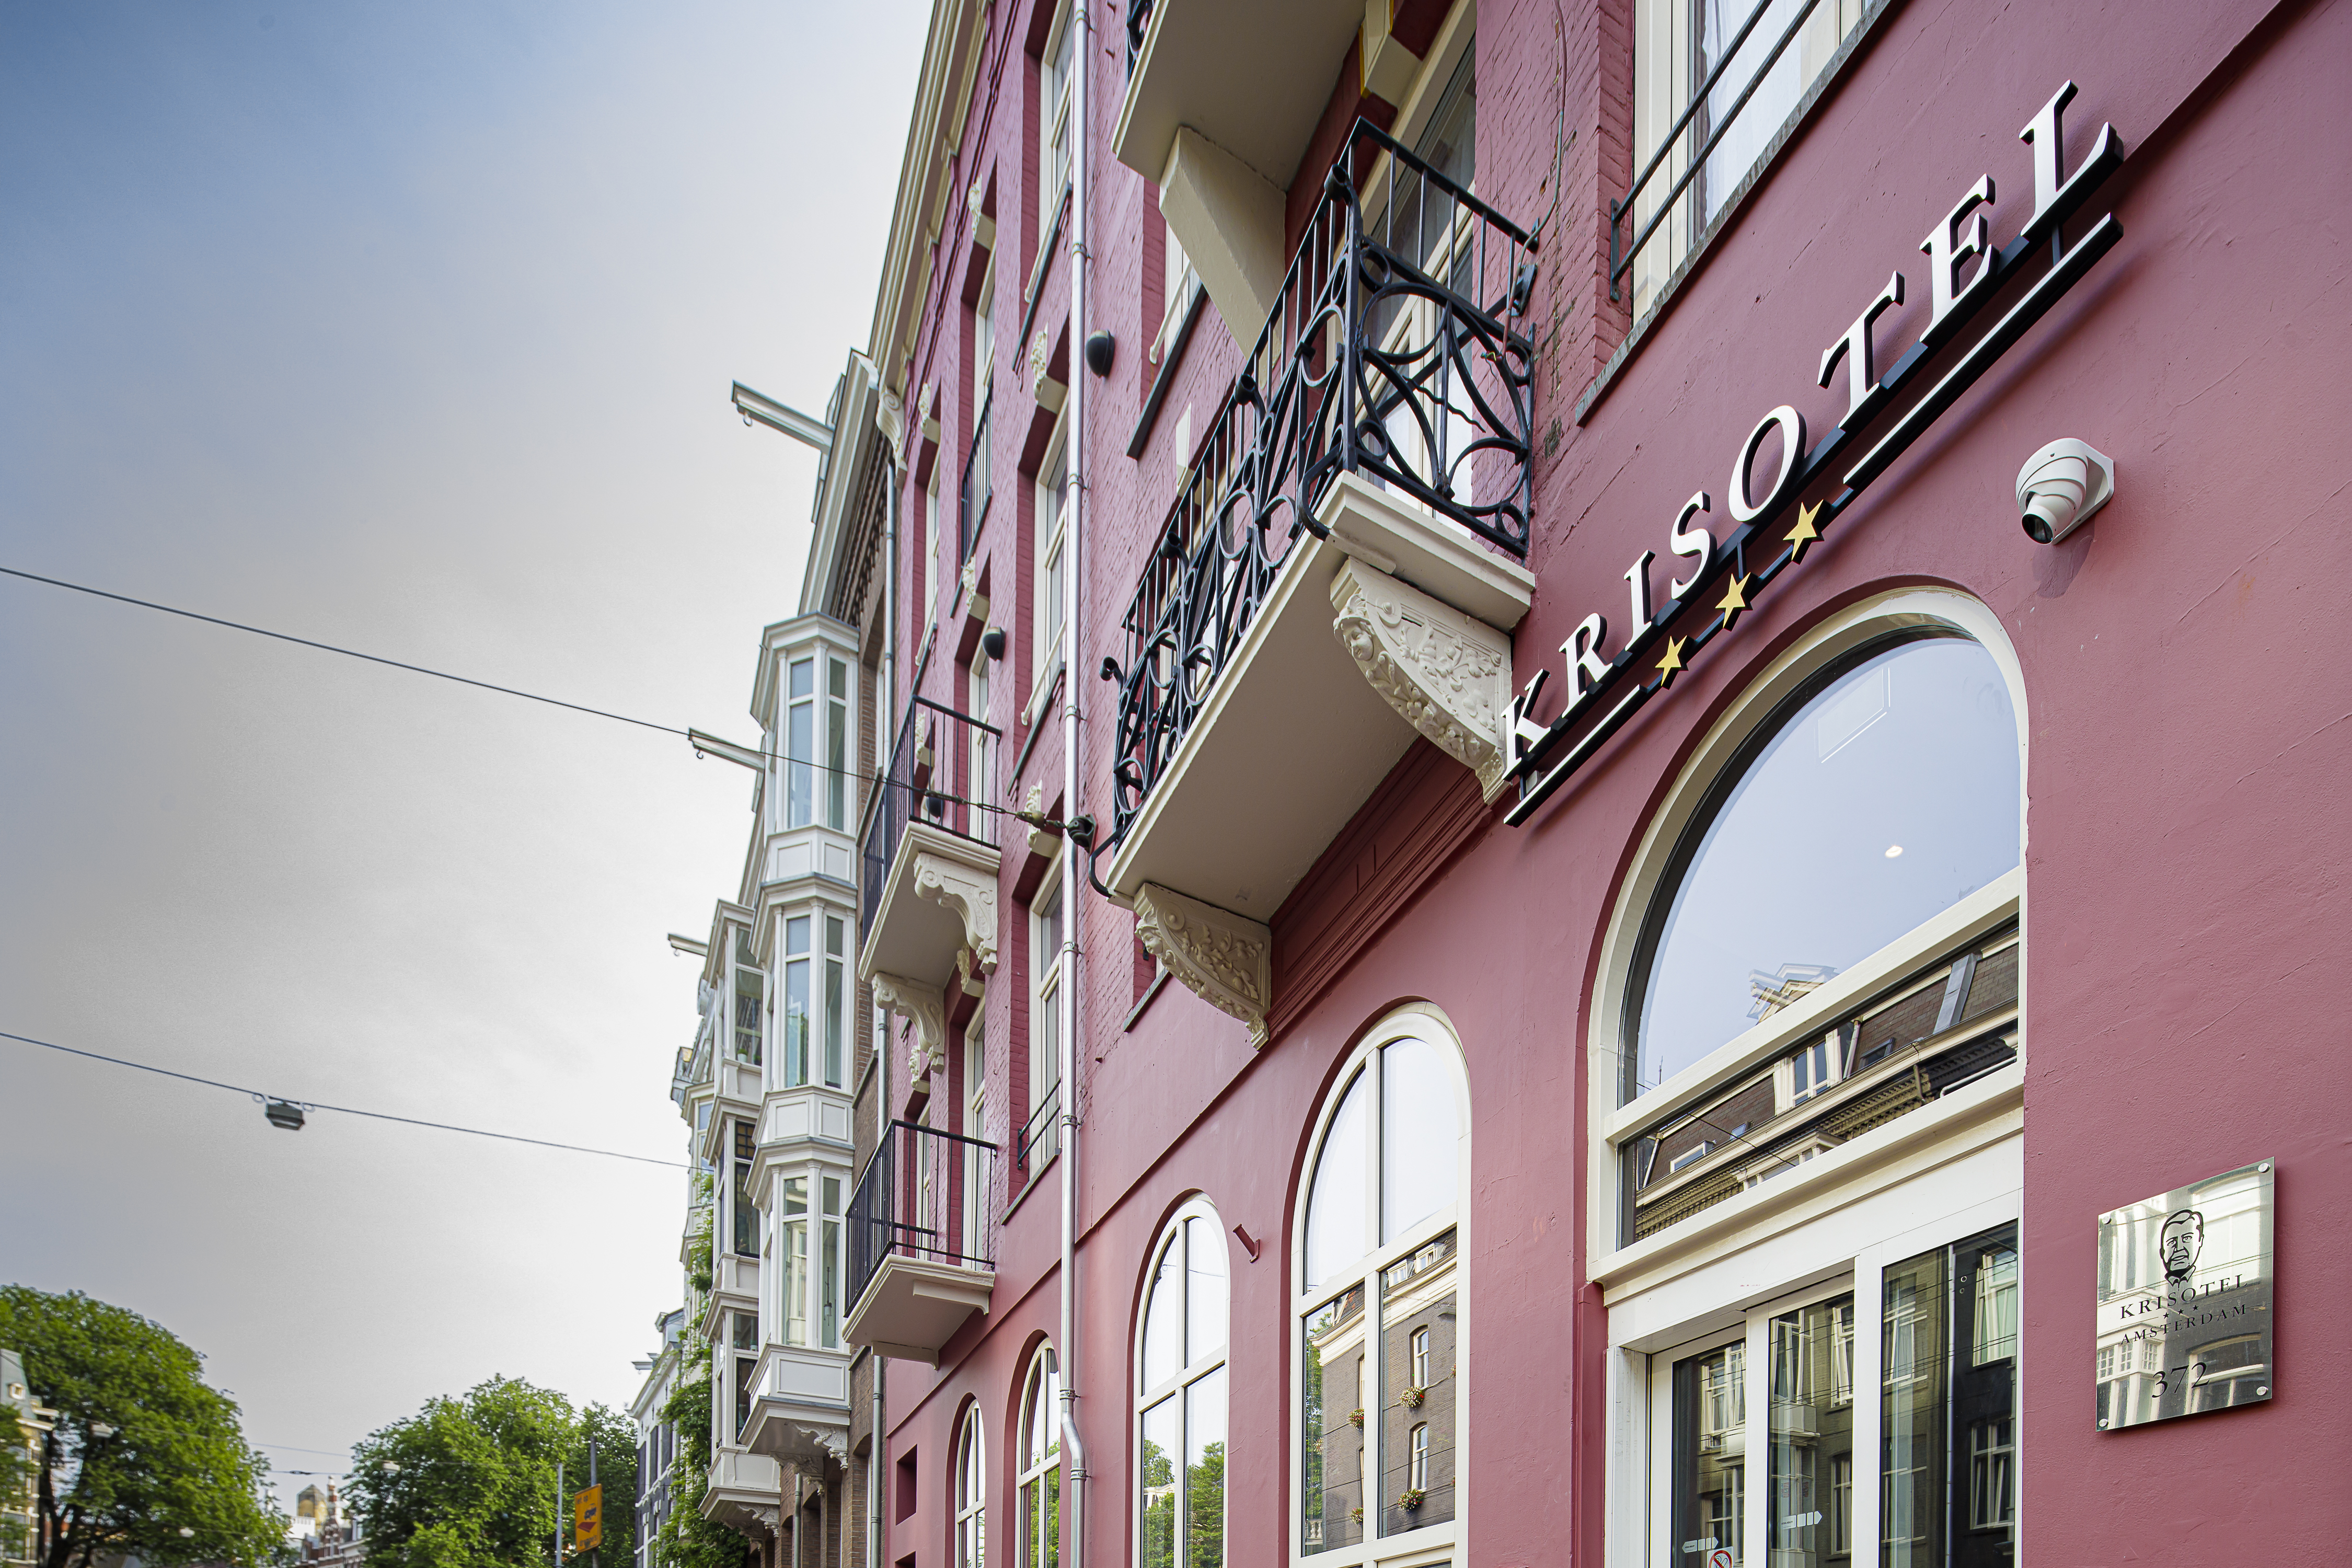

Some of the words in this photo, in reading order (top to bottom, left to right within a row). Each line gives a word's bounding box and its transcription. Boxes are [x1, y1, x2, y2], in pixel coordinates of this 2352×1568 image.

[1501, 79, 2115, 781] KRISOTEL
[2120, 1274, 2247, 1320] KRISOTEL
[2120, 1304, 2246, 1345] AMSTERDAM
[2151, 1362, 2210, 1398] 372
